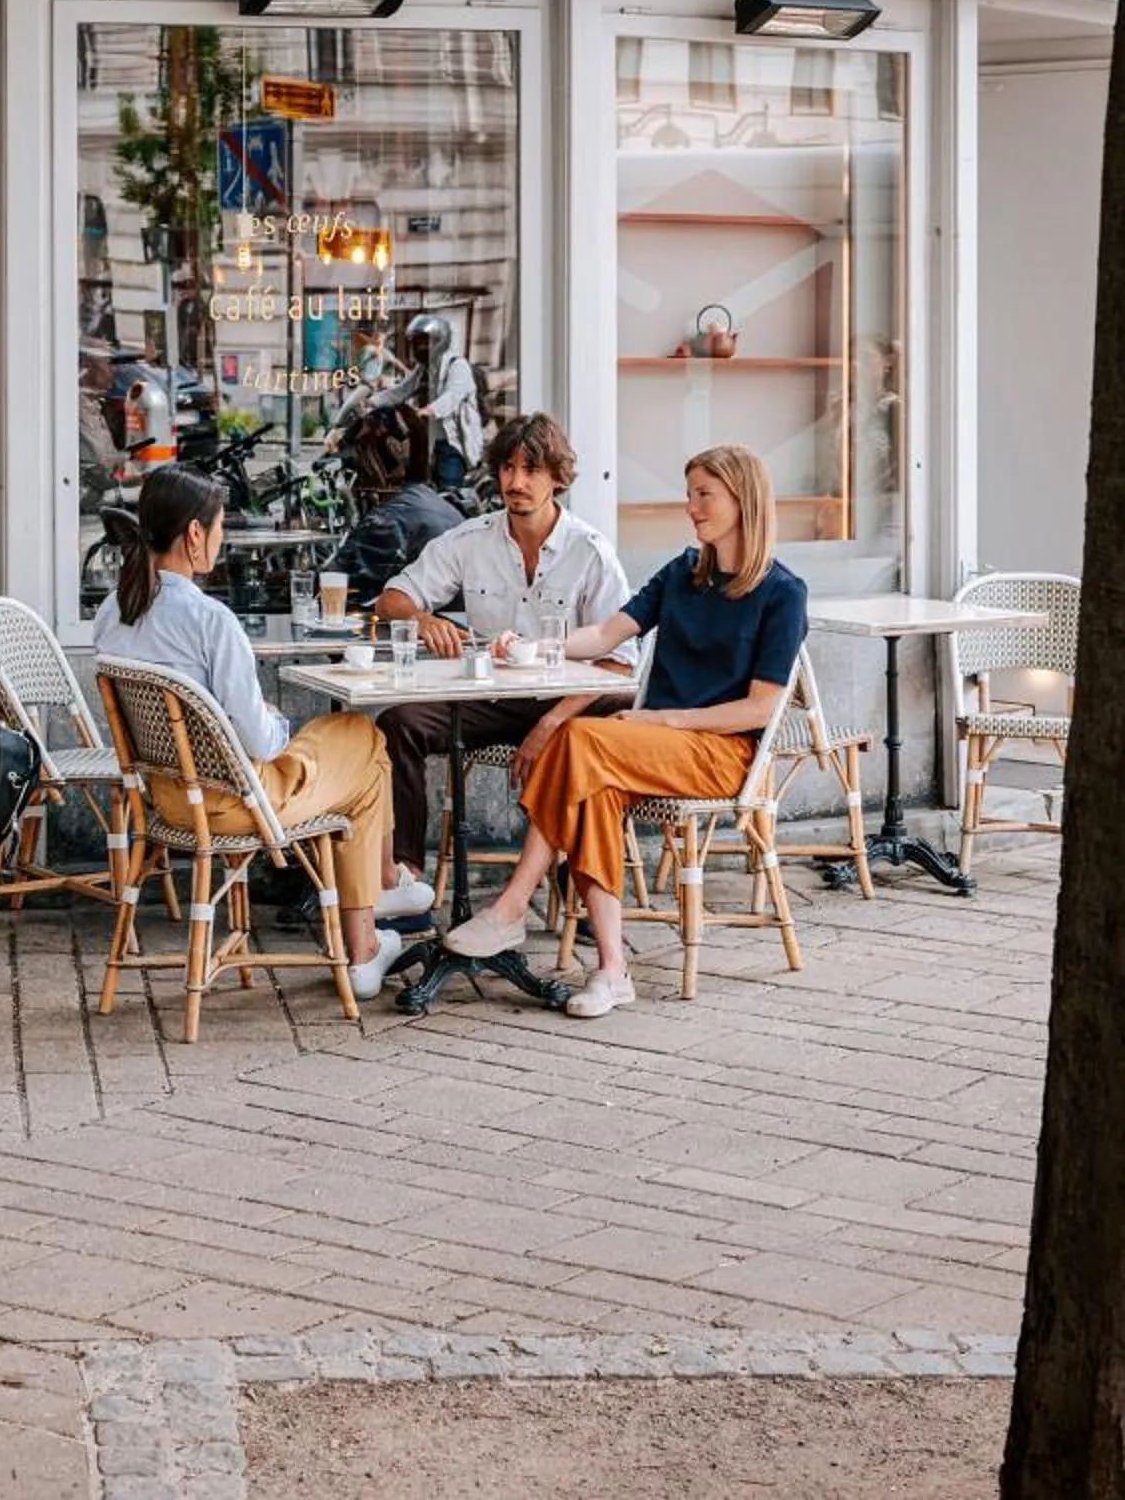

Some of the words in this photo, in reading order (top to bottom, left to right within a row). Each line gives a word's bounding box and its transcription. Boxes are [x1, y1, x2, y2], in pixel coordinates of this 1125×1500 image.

[286, 211, 356, 242] œufs
[209, 284, 277, 321] café
[287, 293, 325, 322] au
[337, 284, 390, 321] lait
